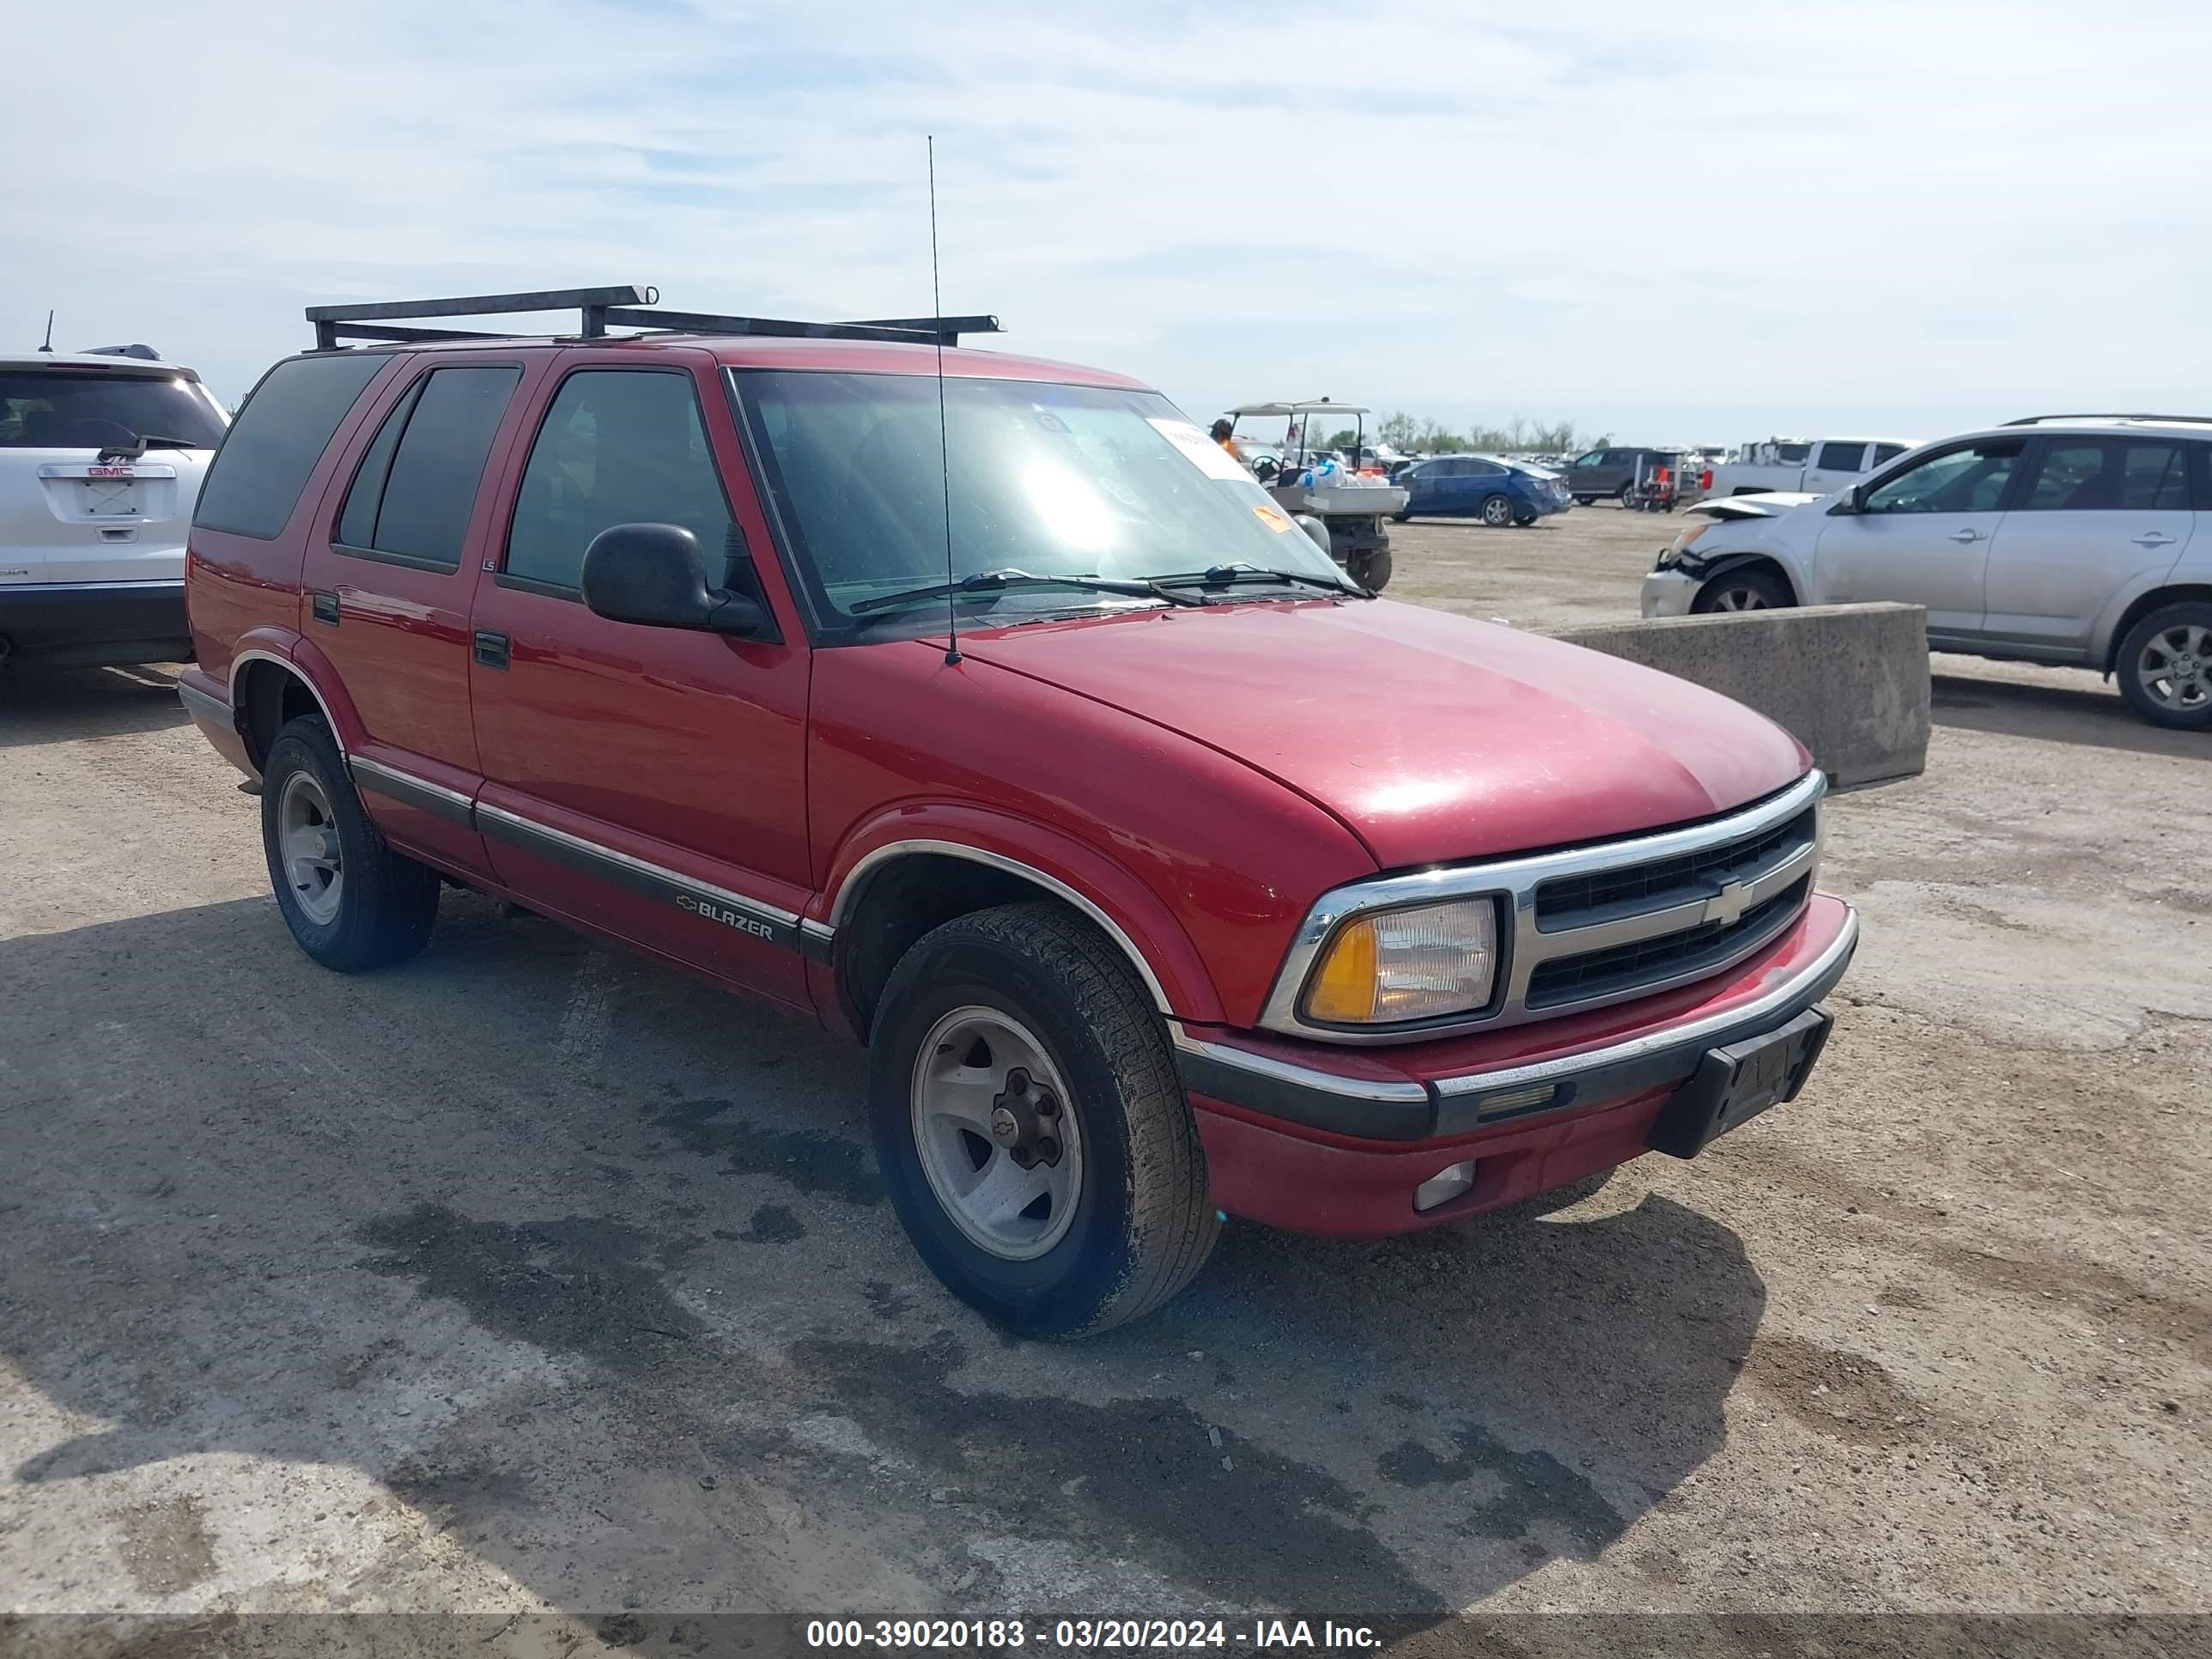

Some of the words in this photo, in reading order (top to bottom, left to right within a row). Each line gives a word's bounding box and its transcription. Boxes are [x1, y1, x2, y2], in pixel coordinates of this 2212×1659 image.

[88, 467, 134, 476] GMC
[483, 558, 495, 571] LS
[698, 901, 774, 942] BLAZER
